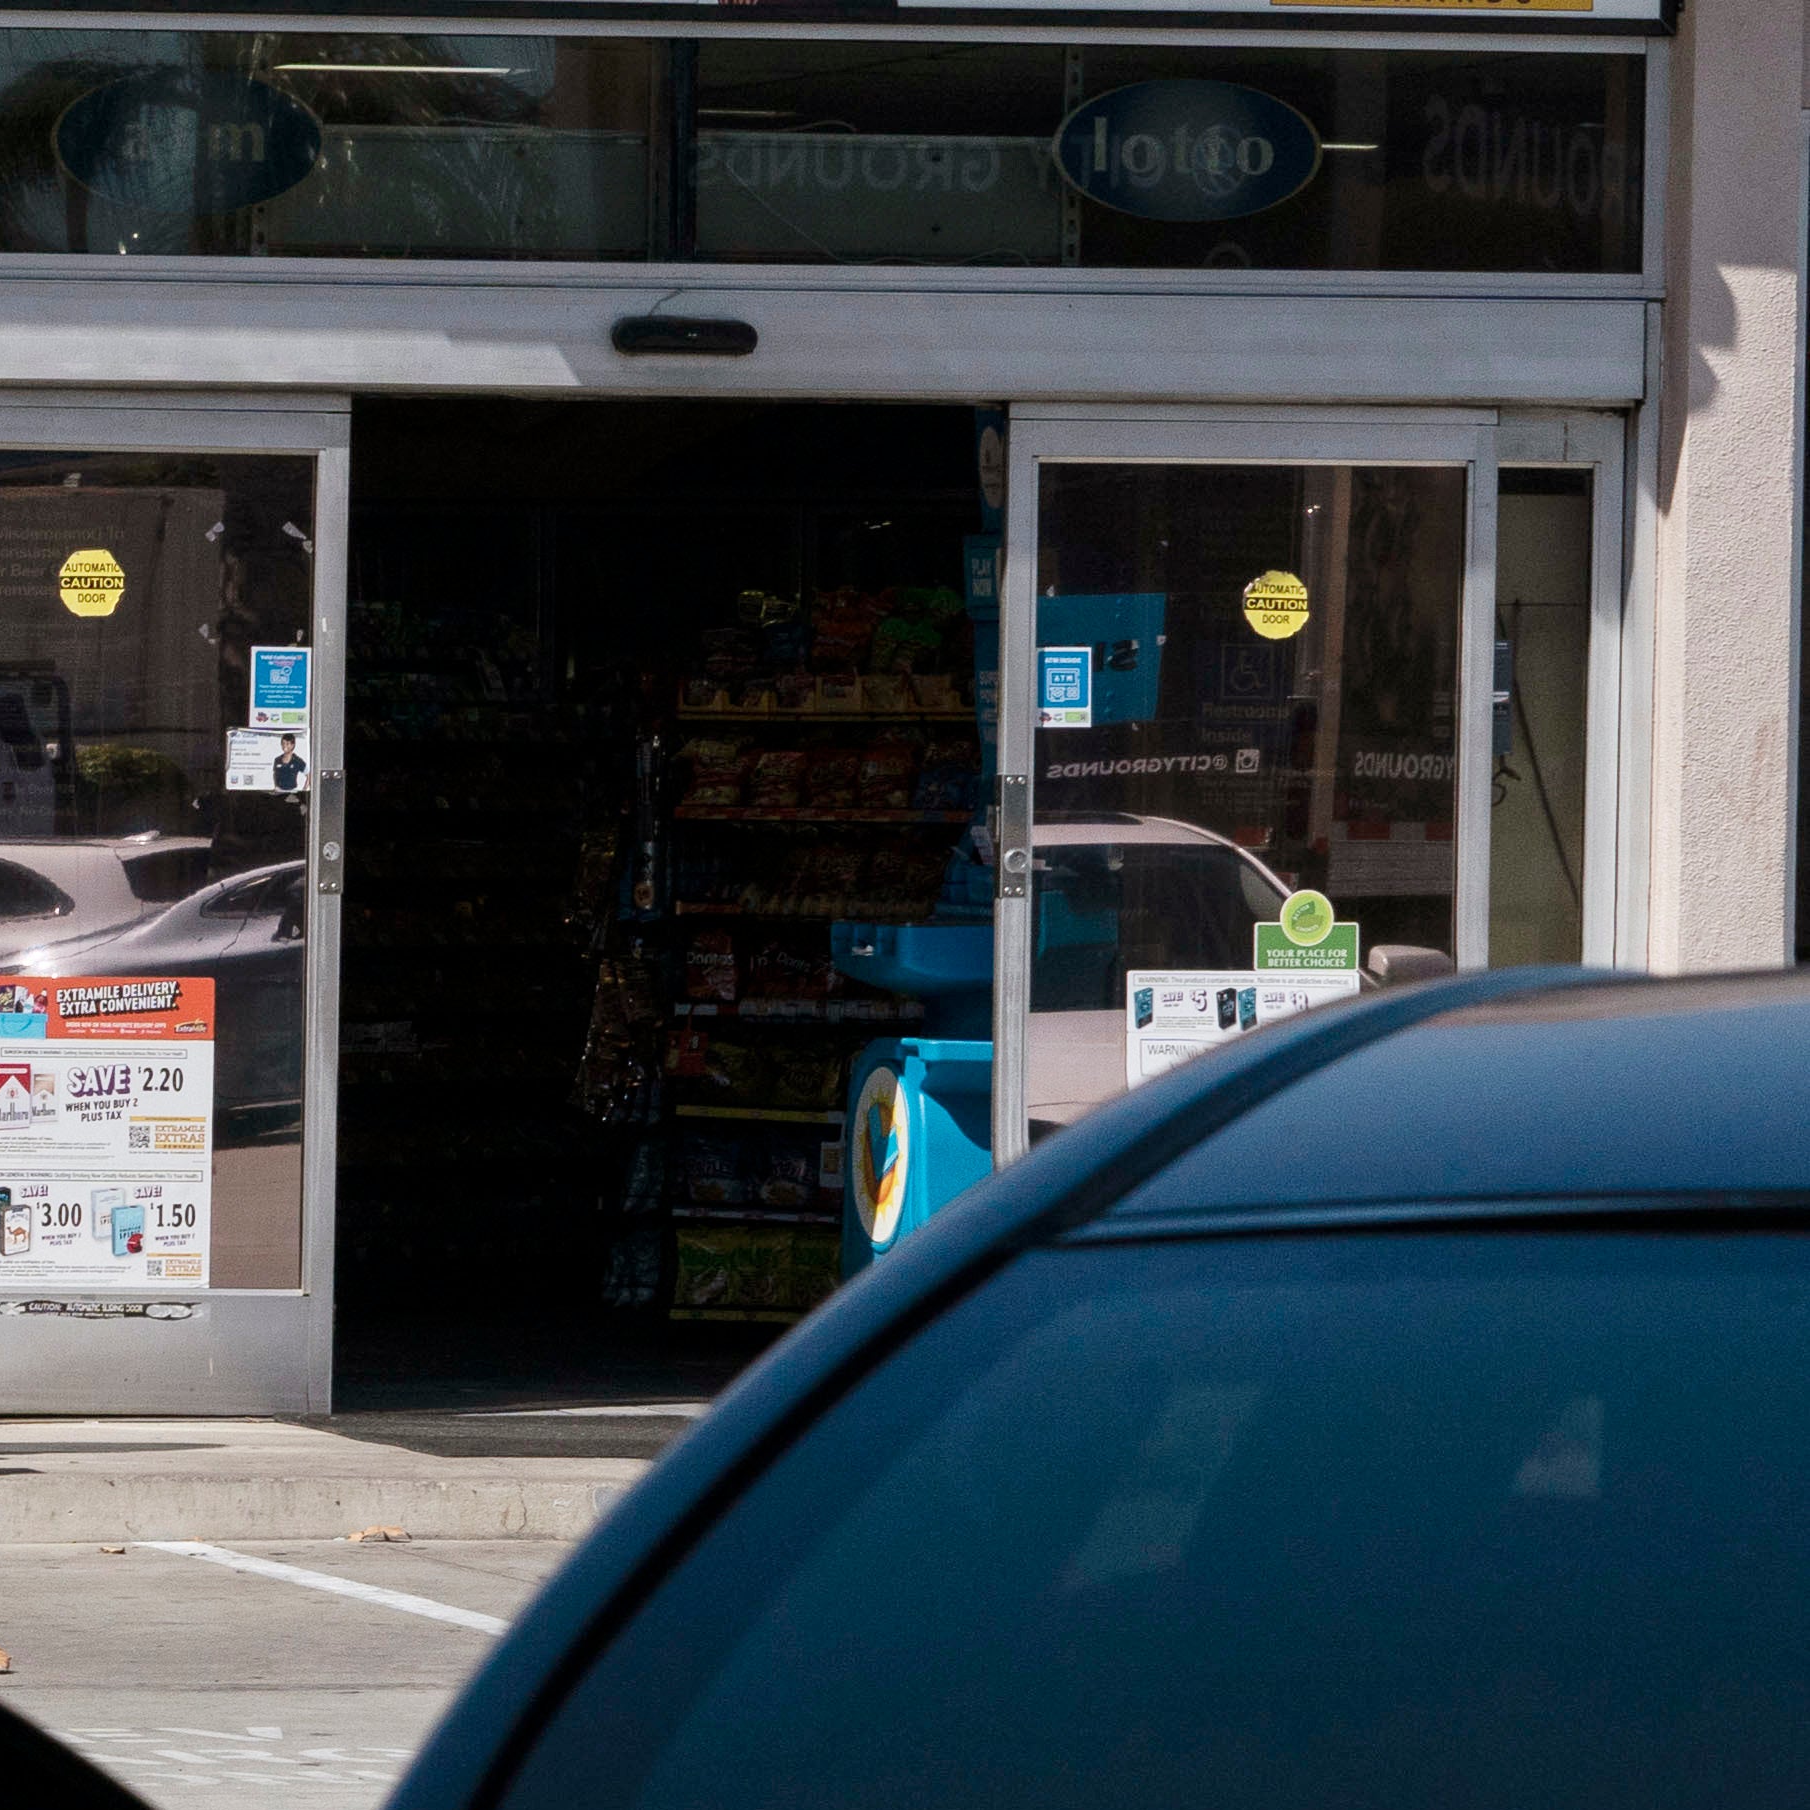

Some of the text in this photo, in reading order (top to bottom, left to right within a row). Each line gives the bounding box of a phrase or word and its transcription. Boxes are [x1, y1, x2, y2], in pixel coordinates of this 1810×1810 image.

[1093, 116, 1277, 176] lotto
[64, 562, 120, 573] AUTOMATIC
[60, 577, 124, 589] CAUTION
[1250, 583, 1306, 596] AUTOMATIC
[77, 593, 106, 603] DOOR
[1245, 598, 1308, 612] CAUTION
[1261, 613, 1291, 626] DOOR
[1266, 948, 1347, 959] YOUR PLACE FOR
[1267, 958, 1347, 968] BETTER CHOICES
[56, 981, 180, 1003] EXTRAMILE DELIVERY.
[59, 996, 177, 1016] EXTRA CONVENIENT.
[66, 1064, 184, 1098] SAVE $2.20
[65, 1097, 139, 1112] WHEN YOU BUY 2
[80, 1111, 123, 1123] PLUS TAX
[154, 1133, 206, 1144] EXTRAS
[20, 1185, 49, 1198] SAVE!
[134, 1186, 163, 1199] SAVE!
[36, 1202, 82, 1228] $3.00
[150, 1202, 196, 1228] $1.50
